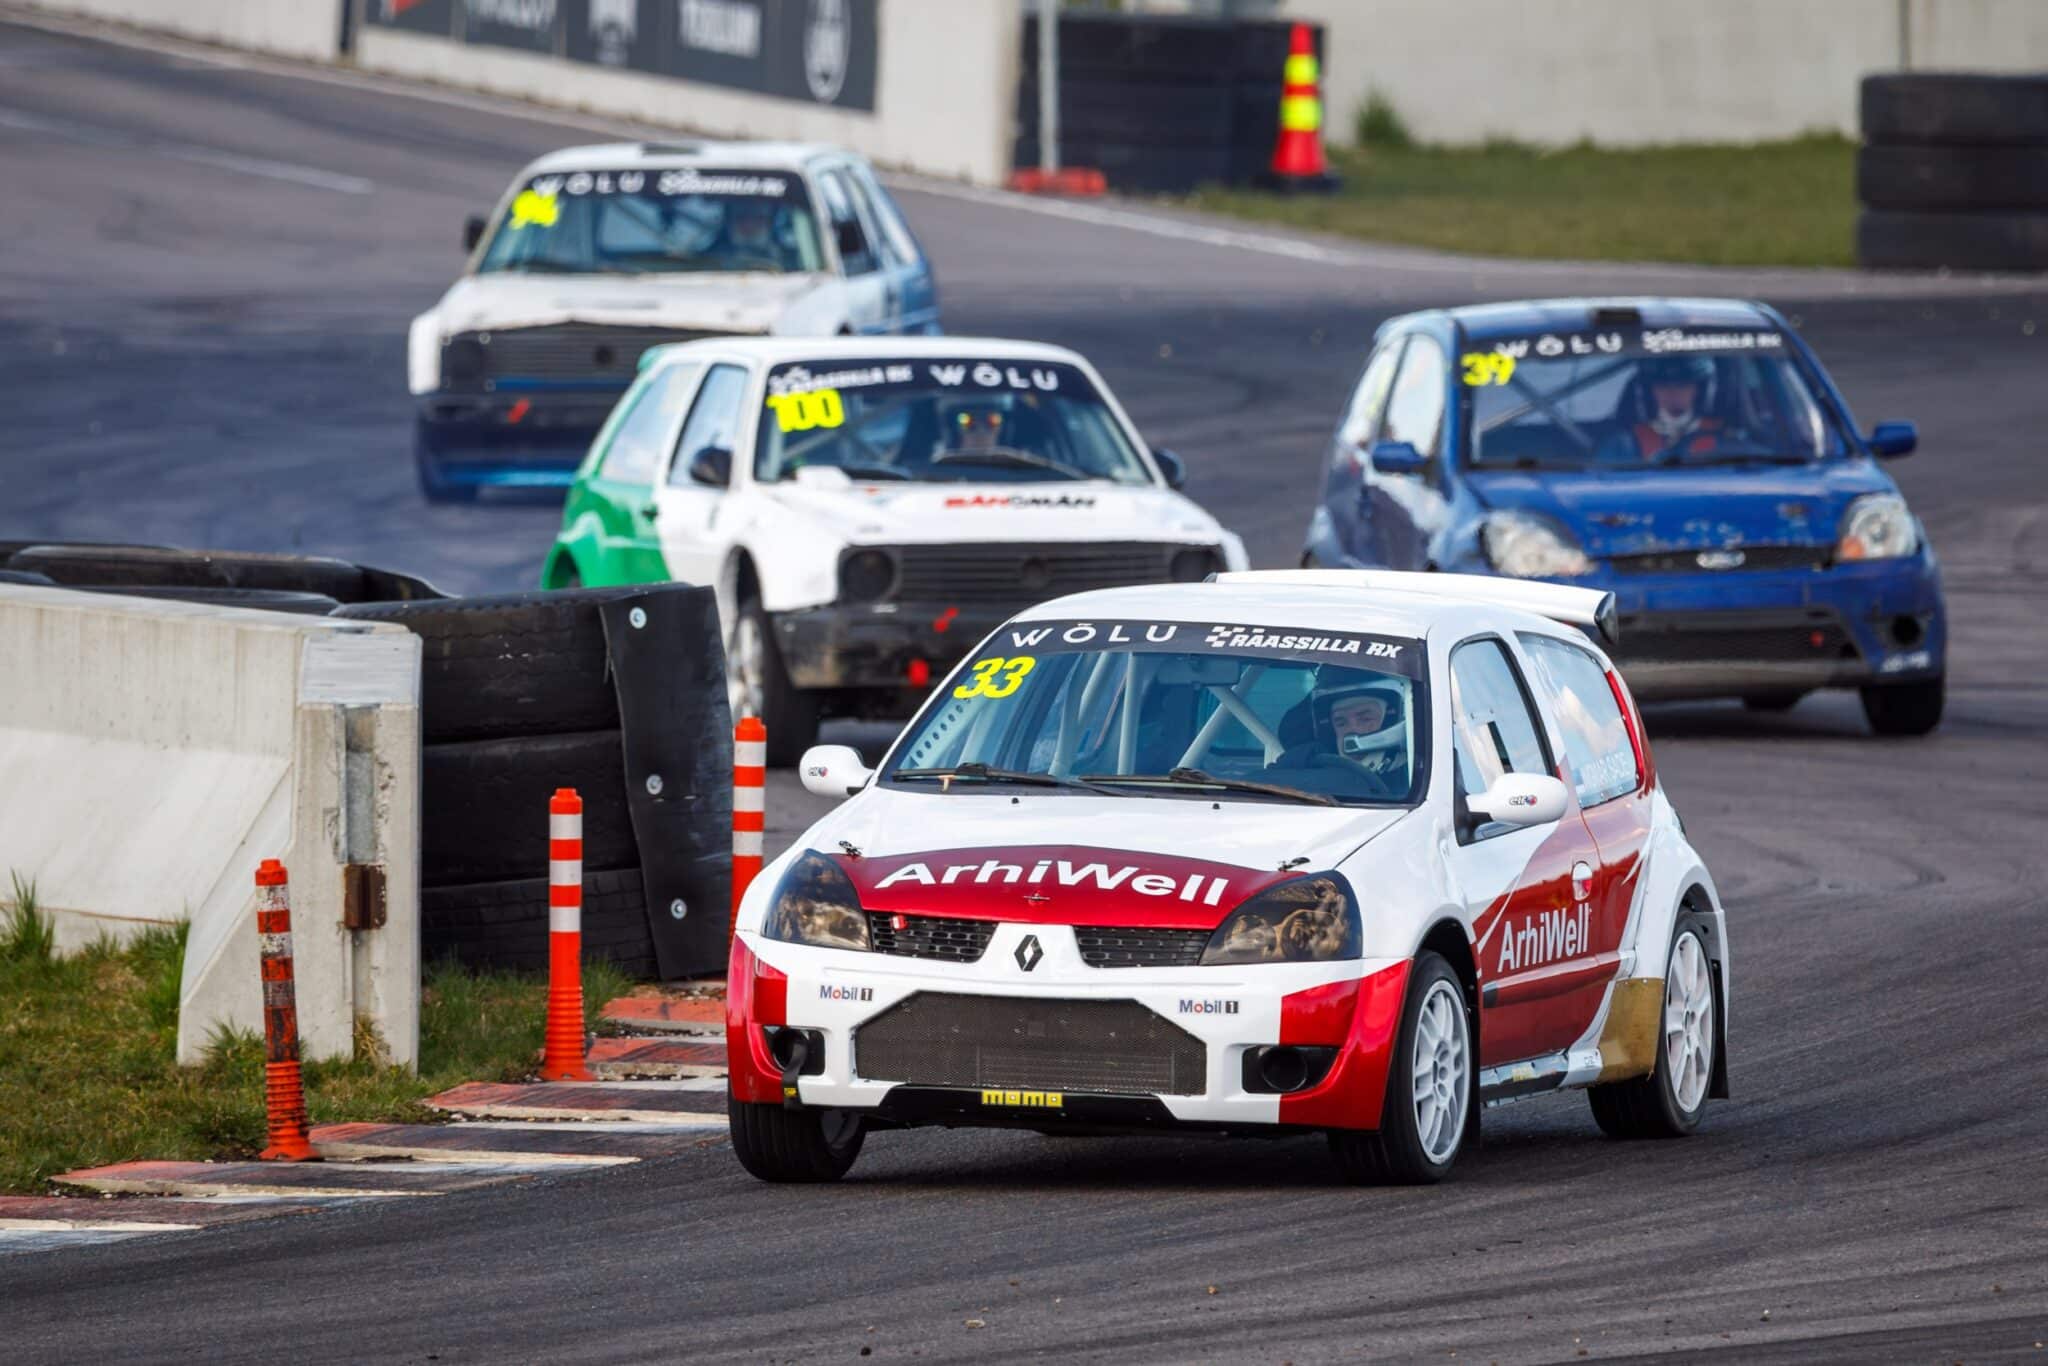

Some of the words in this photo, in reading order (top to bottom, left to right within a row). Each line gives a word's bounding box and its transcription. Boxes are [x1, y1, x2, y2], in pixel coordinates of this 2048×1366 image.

[1461, 352, 1516, 386] 39
[767, 389, 844, 433] 100
[1011, 623, 1177, 648] WÕLU
[1229, 634, 1361, 653] RAASSILLA
[1366, 642, 1404, 658] RX
[952, 656, 1036, 699] 33
[874, 860, 1229, 906] ArhiWell
[1497, 902, 1589, 973] ArhiWell
[820, 984, 858, 1000] Mobil
[861, 988, 872, 1001] 1
[1179, 999, 1221, 1014] Mobil
[1225, 1001, 1238, 1013] 1
[982, 1090, 1063, 1108] momo
